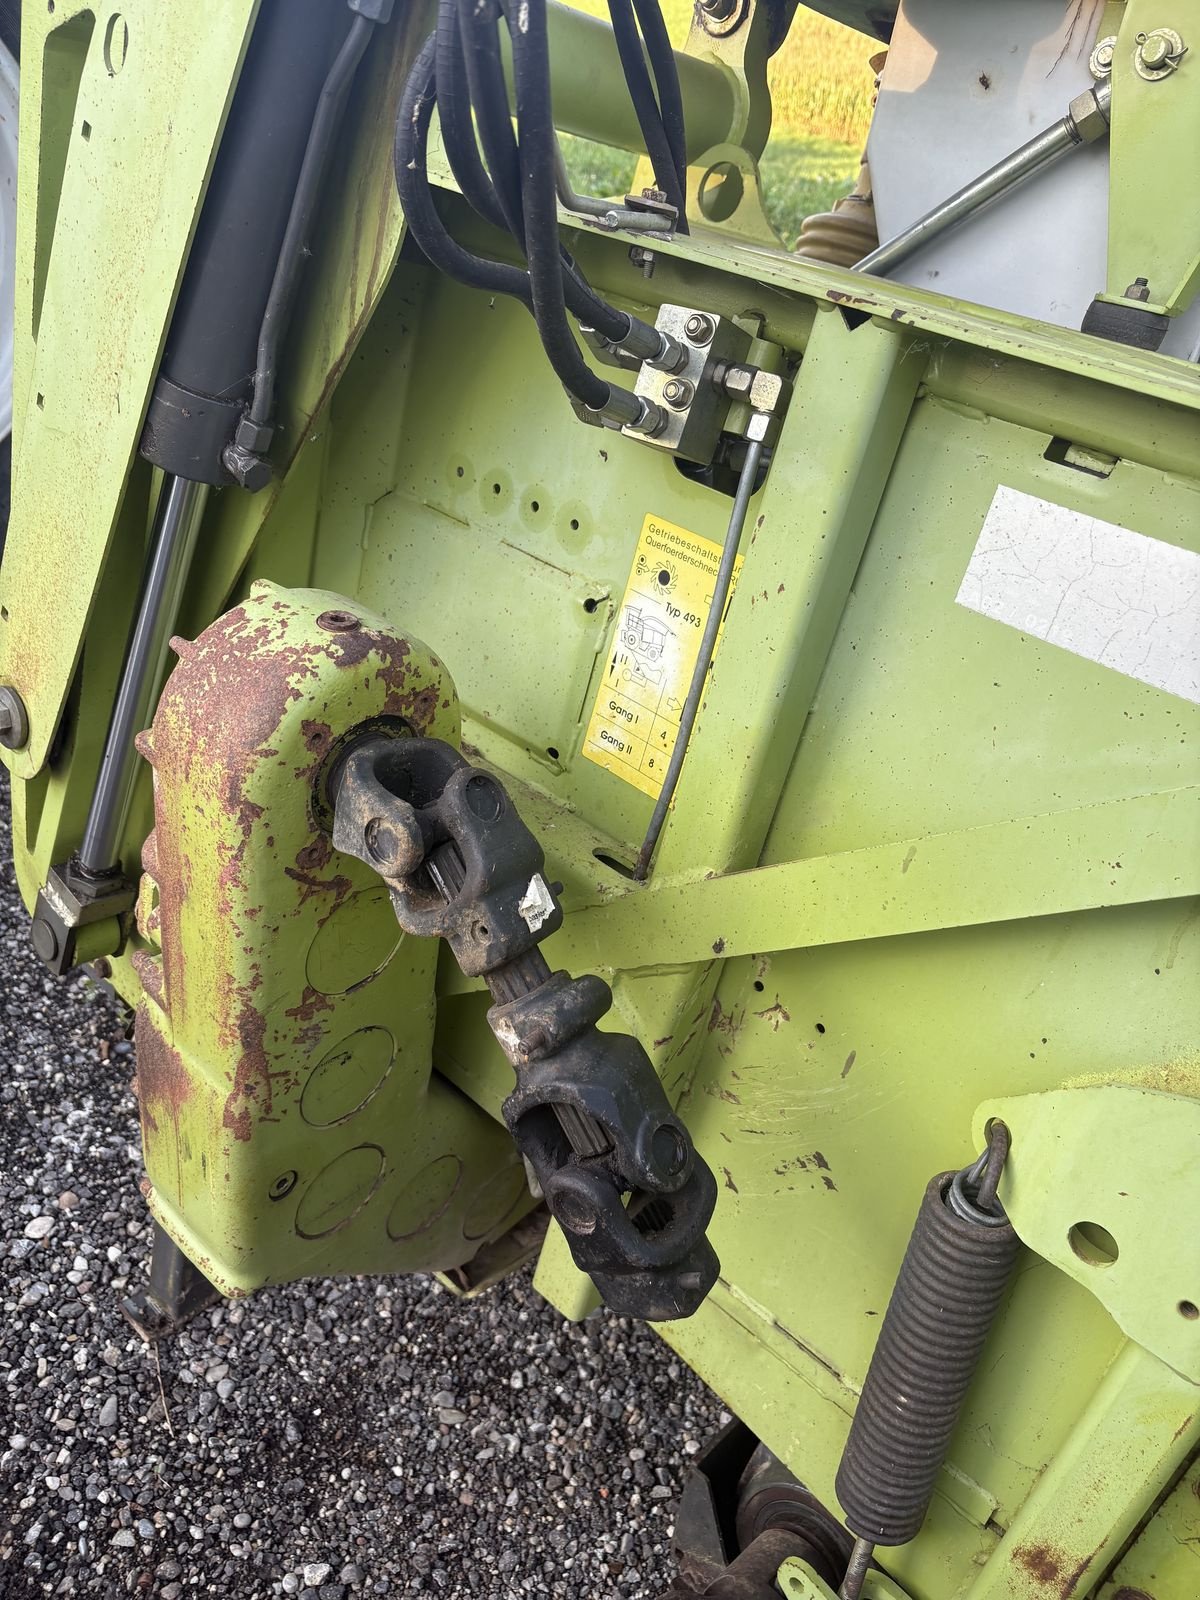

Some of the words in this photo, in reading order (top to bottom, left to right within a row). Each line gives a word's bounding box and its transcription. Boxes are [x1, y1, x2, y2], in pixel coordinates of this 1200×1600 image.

[645, 535, 719, 577] Querfoerderschnec
[665, 601, 681, 618] Typ
[683, 612, 702, 628] 493
[608, 700, 634, 723] Gang
[634, 715, 639, 724] I
[600, 730, 625, 752] Gang
[626, 745, 633, 755] II
[660, 731, 667, 740] 4
[648, 758, 655, 768] 8
